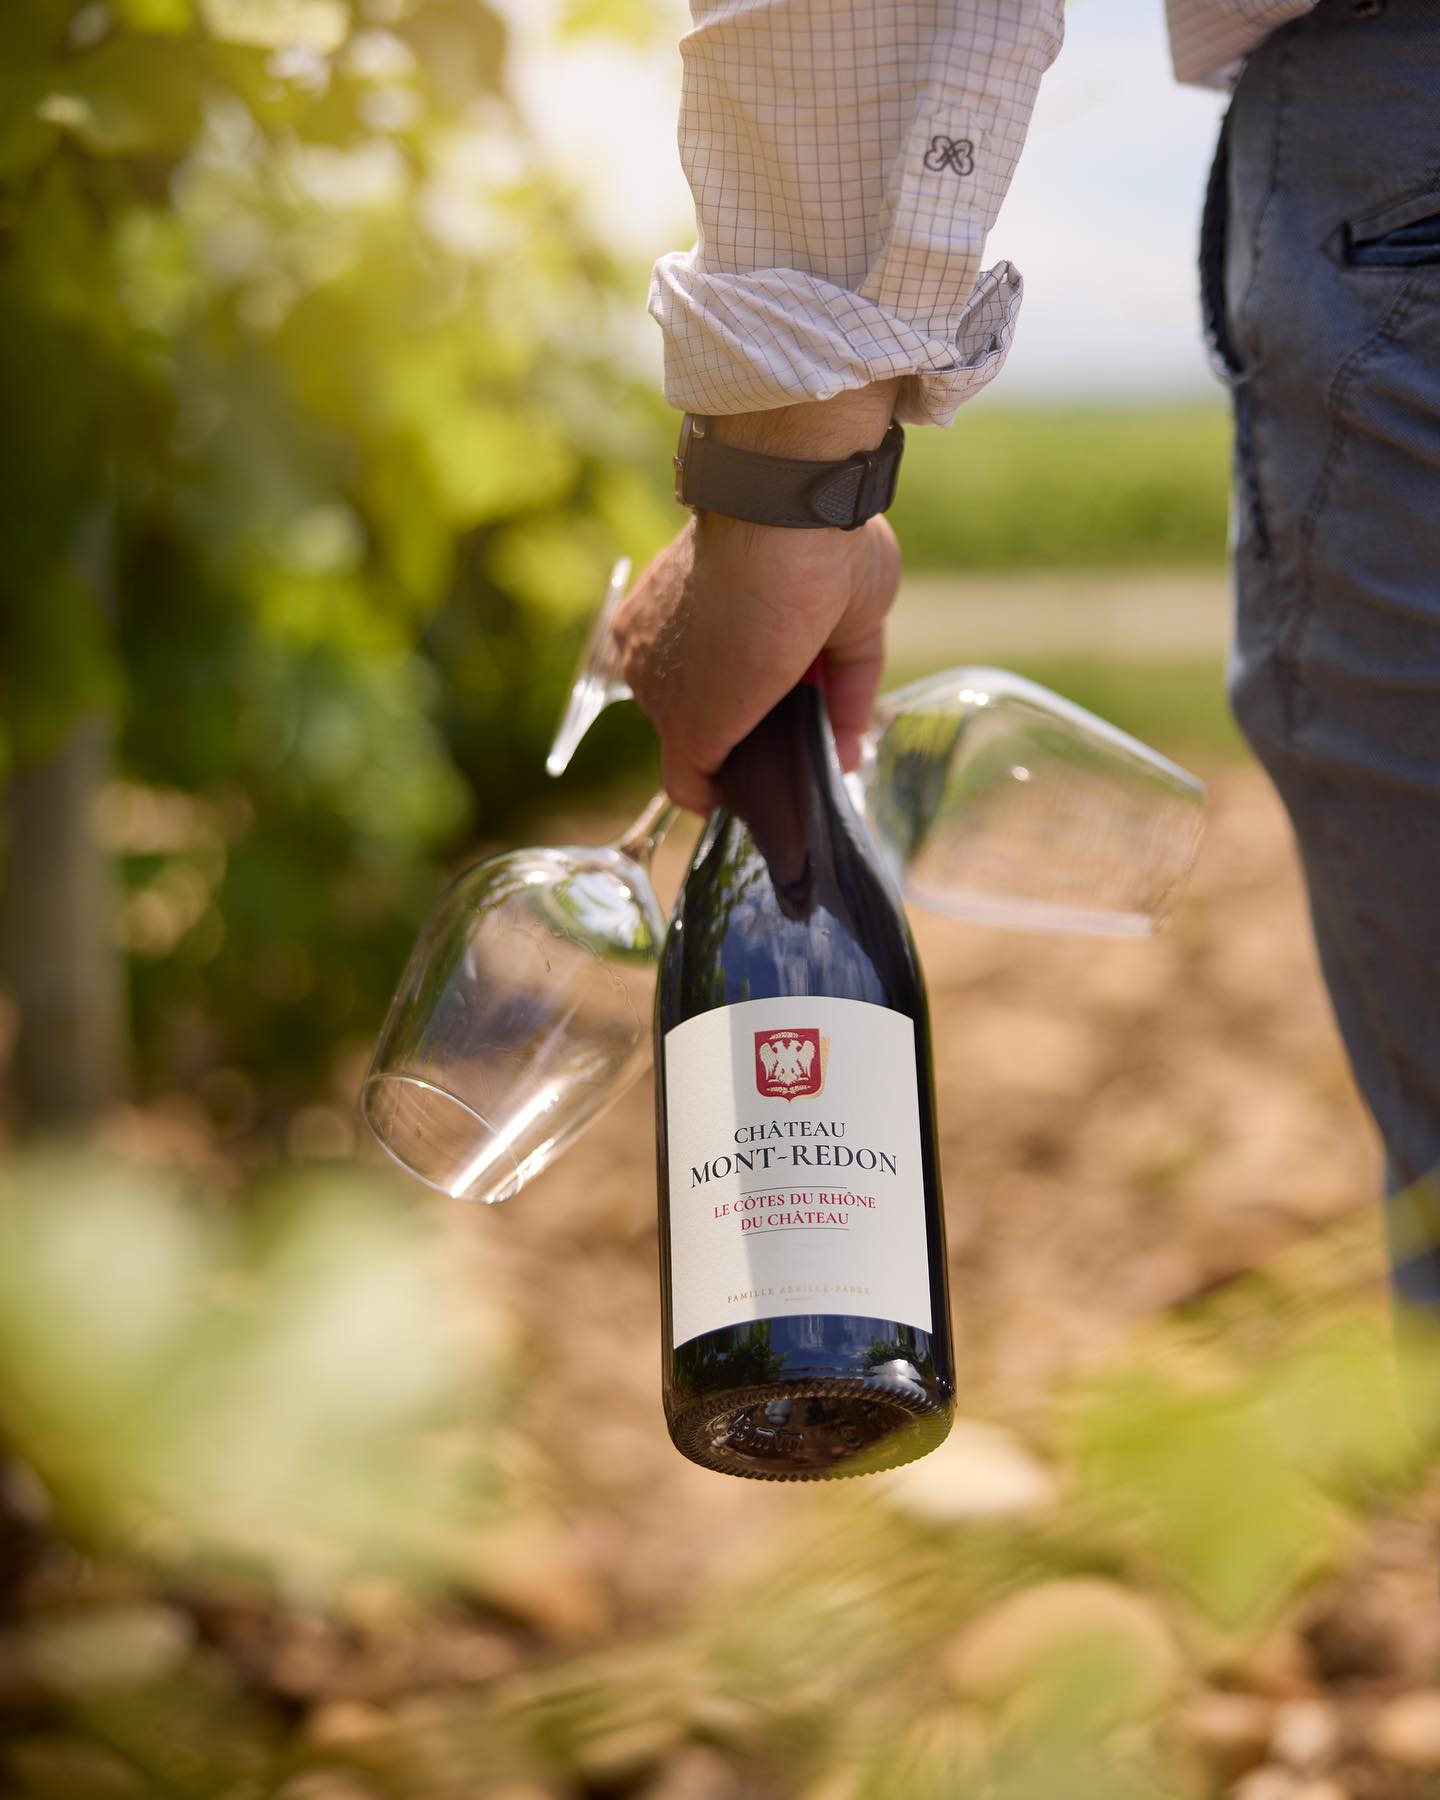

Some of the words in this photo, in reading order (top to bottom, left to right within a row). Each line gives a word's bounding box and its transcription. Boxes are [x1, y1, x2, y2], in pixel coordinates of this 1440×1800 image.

[734, 1120, 846, 1144] CHÂTEAU
[690, 1144, 898, 1188] MONT-REDON
[713, 1203, 730, 1219] LE
[733, 1195, 785, 1213] CÔTES
[790, 1193, 814, 1205] DU
[819, 1191, 877, 1209] RHÔNE
[740, 1215, 763, 1231] DU
[767, 1210, 849, 1225] CHÂTEAU
[727, 1287, 773, 1303] FAMILLE
